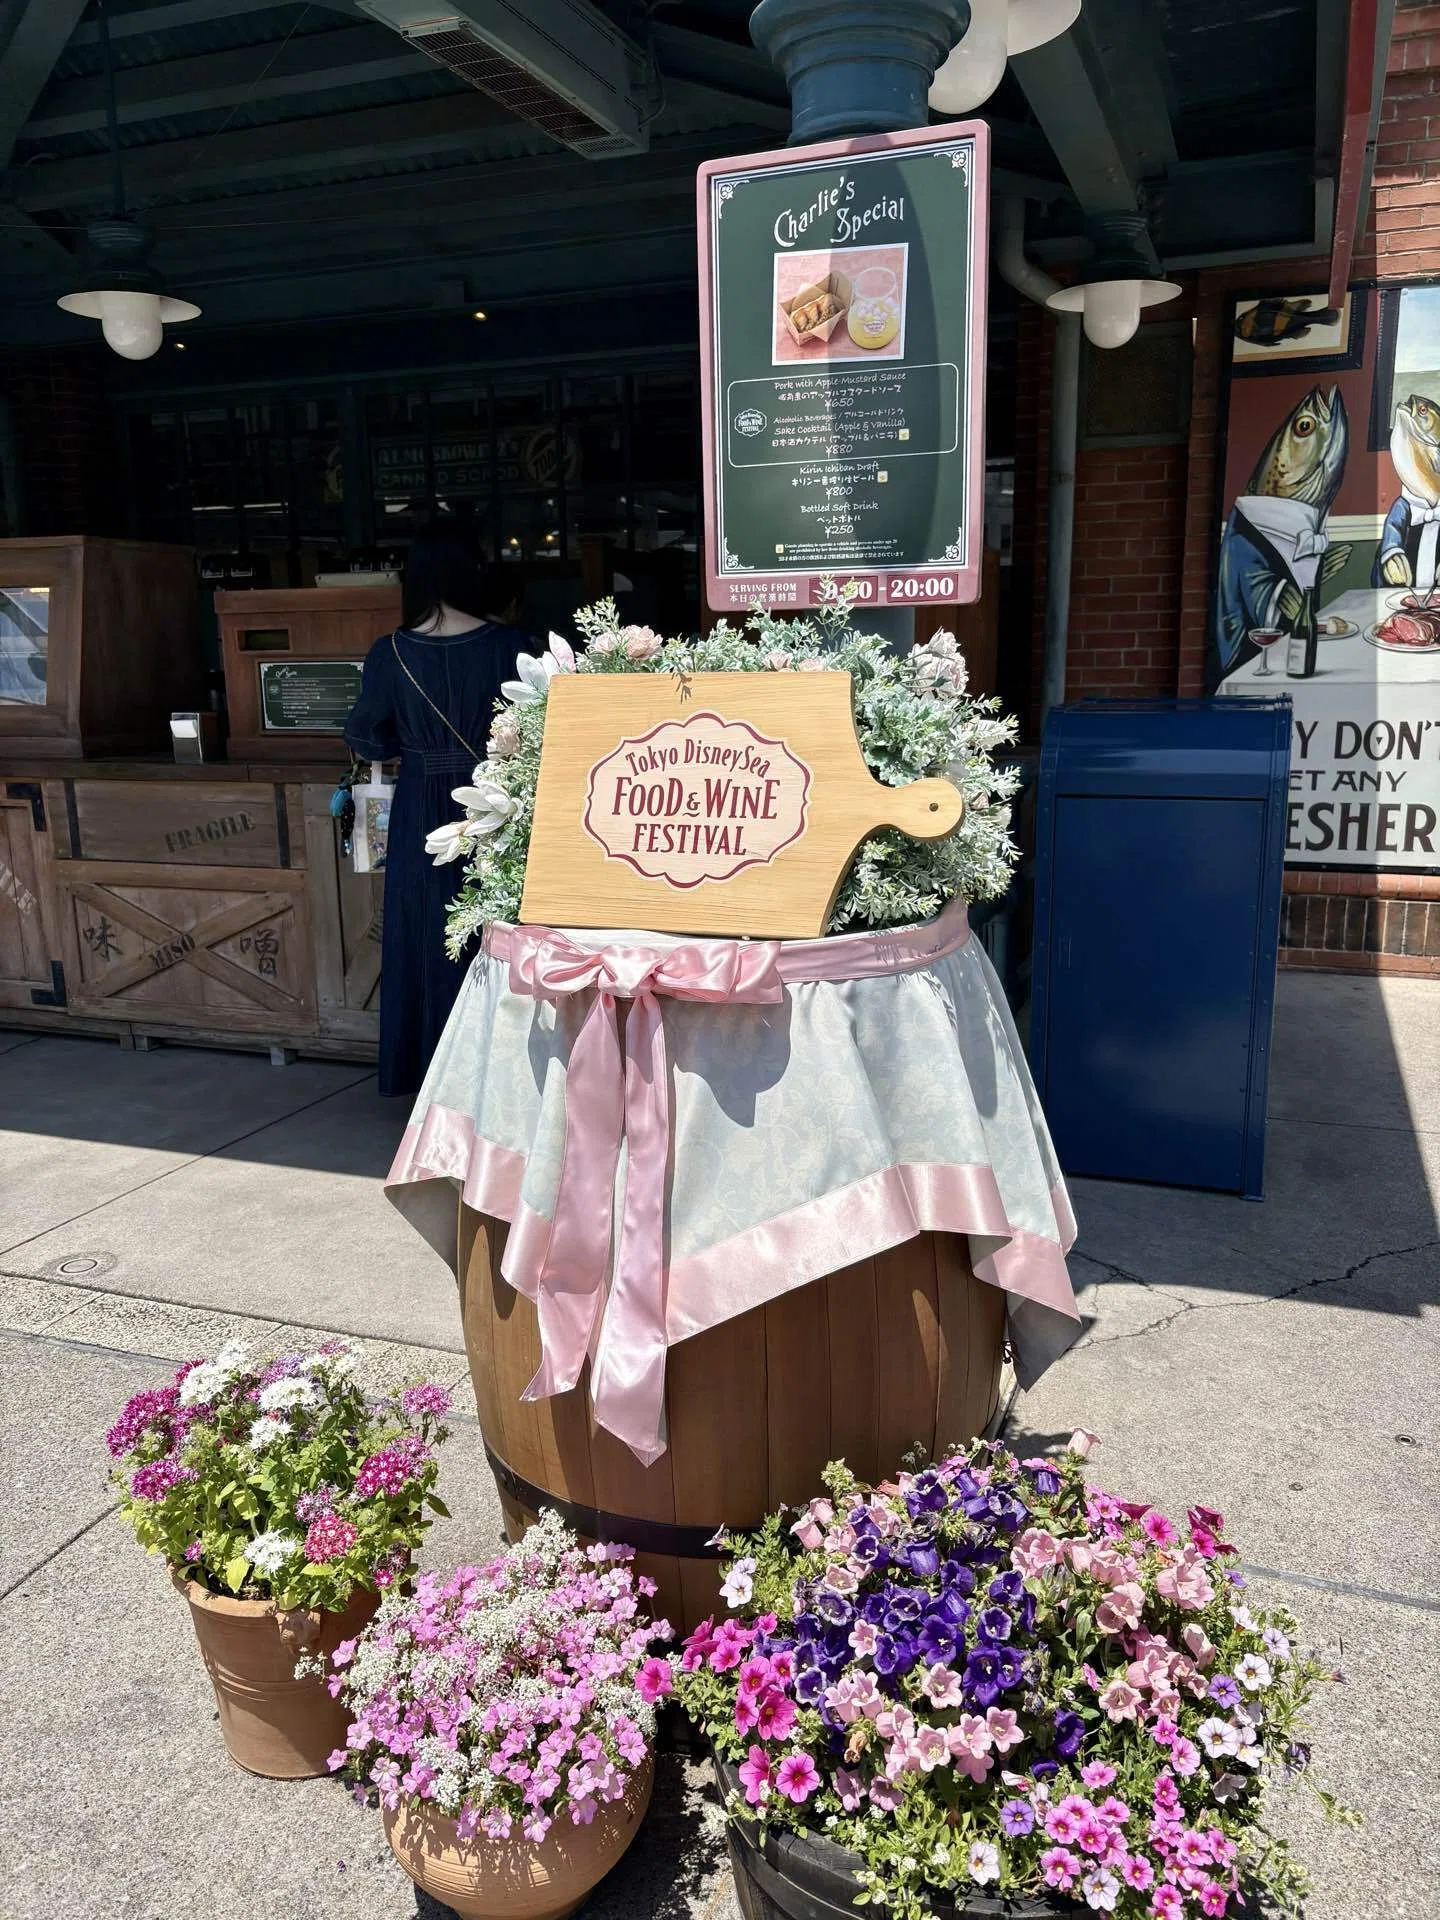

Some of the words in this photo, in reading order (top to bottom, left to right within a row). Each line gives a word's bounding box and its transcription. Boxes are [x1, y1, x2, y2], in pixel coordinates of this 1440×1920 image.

[773, 176, 856, 248] Charlie's
[830, 195, 905, 243] Special
[774, 380, 794, 390] Pork
[795, 378, 814, 389] with
[815, 376, 839, 389] Apple
[841, 373, 877, 384] Mustard
[880, 372, 906, 381] Sauce
[824, 397, 854, 412] ¥650
[773, 414, 803, 424] Alcoholic
[774, 426, 796, 435] Sake
[797, 423, 832, 433] Cocktail
[834, 422, 861, 433] (Apple
[825, 444, 853, 458] ¥880
[799, 464, 823, 475] Kirin
[825, 464, 855, 473] Ichiban
[857, 460, 880, 472] Draft
[825, 486, 853, 500] ¥800
[800, 503, 830, 513] Bottled
[831, 502, 852, 513] Soft
[853, 500, 879, 510] Drink
[816, 514, 861, 524] ペットボトル
[824, 525, 854, 539] ¥250
[729, 583, 768, 593] SERVING
[771, 582, 797, 592] FROM
[824, 581, 873, 600] 9:0
[890, 577, 954, 598] 20:00
[1334, 719, 1440, 761] DON'
[625, 745, 679, 777] Tokyo
[683, 738, 771, 779] DisneySea
[1331, 770, 1407, 792] ANY
[611, 776, 684, 817] FOOD
[683, 791, 701, 818] &
[704, 778, 781, 820] WINE
[164, 812, 257, 853] FRAGILE
[632, 823, 747, 856] FESTIVAL
[150, 933, 196, 969] MISO
